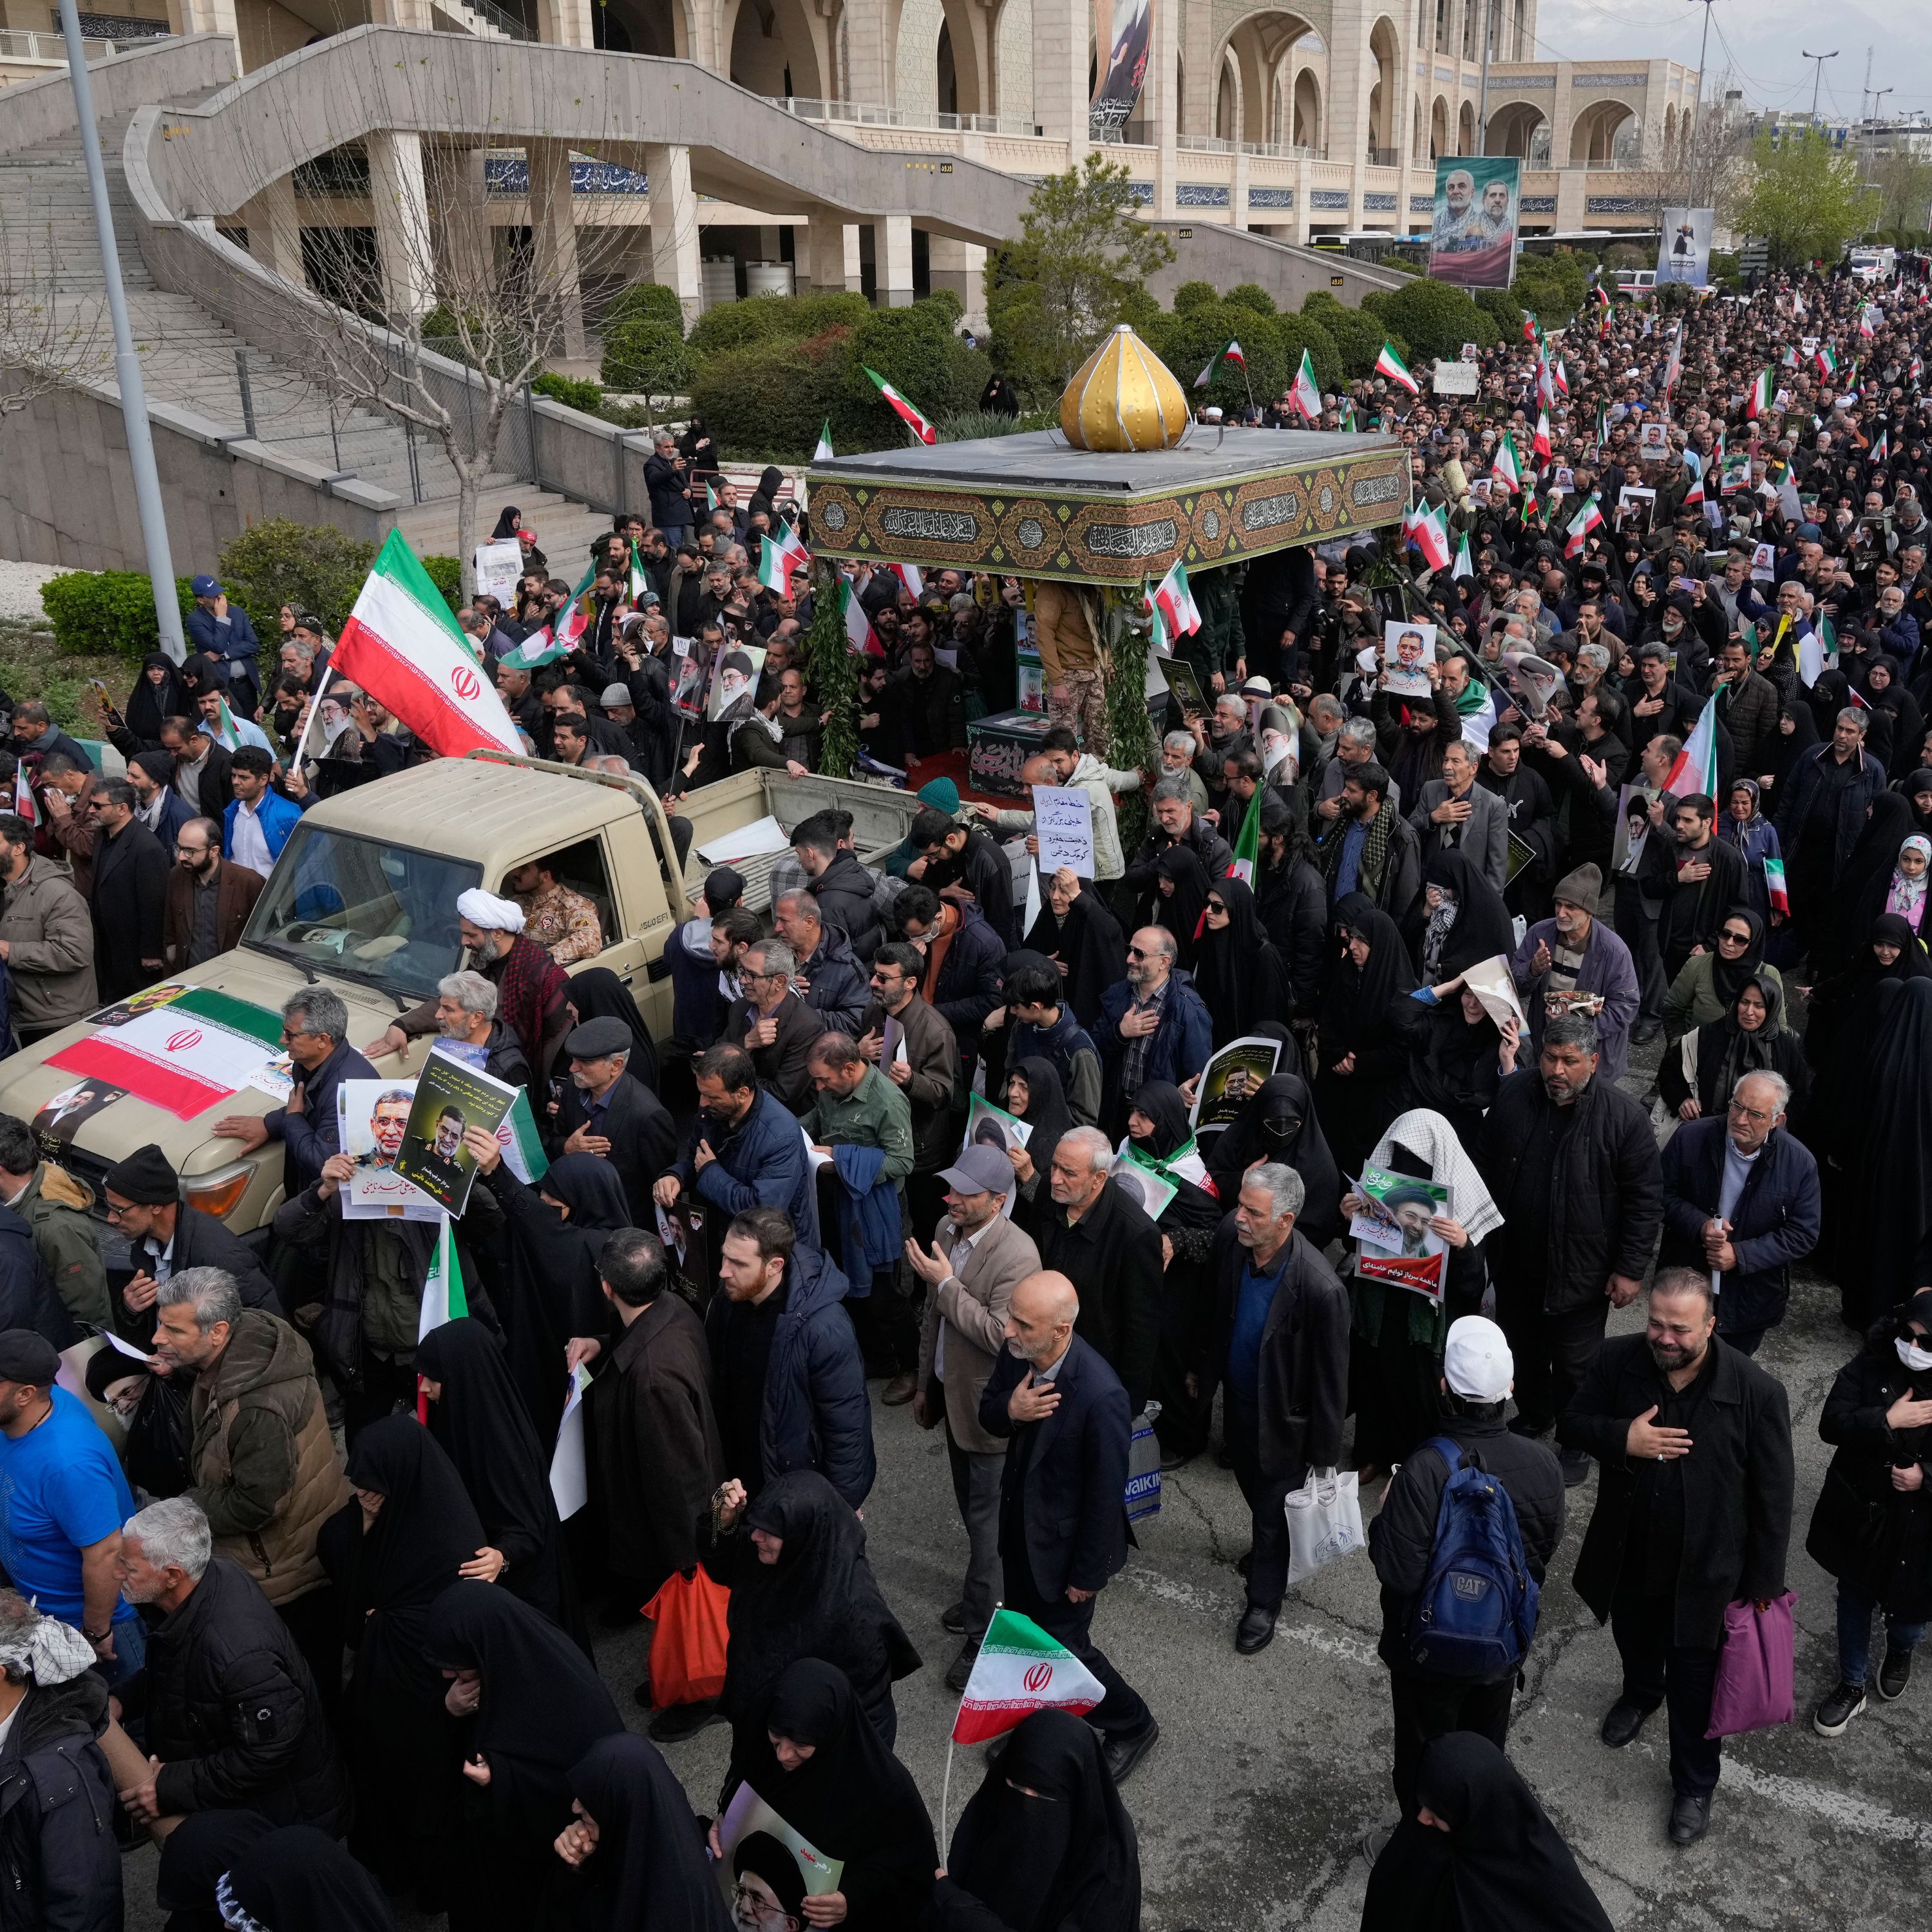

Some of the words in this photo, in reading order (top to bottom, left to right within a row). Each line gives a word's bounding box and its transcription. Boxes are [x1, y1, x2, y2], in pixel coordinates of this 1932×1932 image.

[1040, 795, 1053, 808] ایران
[1054, 797, 1068, 808] مقدم
[1068, 797, 1084, 808] خط
[1041, 815, 1048, 824] از
[1065, 814, 1082, 826] خیلی
[1065, 836, 1088, 846] ذهنیت
[1051, 845, 1069, 857] دشمن
[1388, 1268, 1403, 1276] توایم
[1403, 1272, 1419, 1280] سرباز
[1456, 1577, 1481, 1596] CAT
[800, 1848, 816, 1862] شهید
[814, 1861, 831, 1873] رهبر
